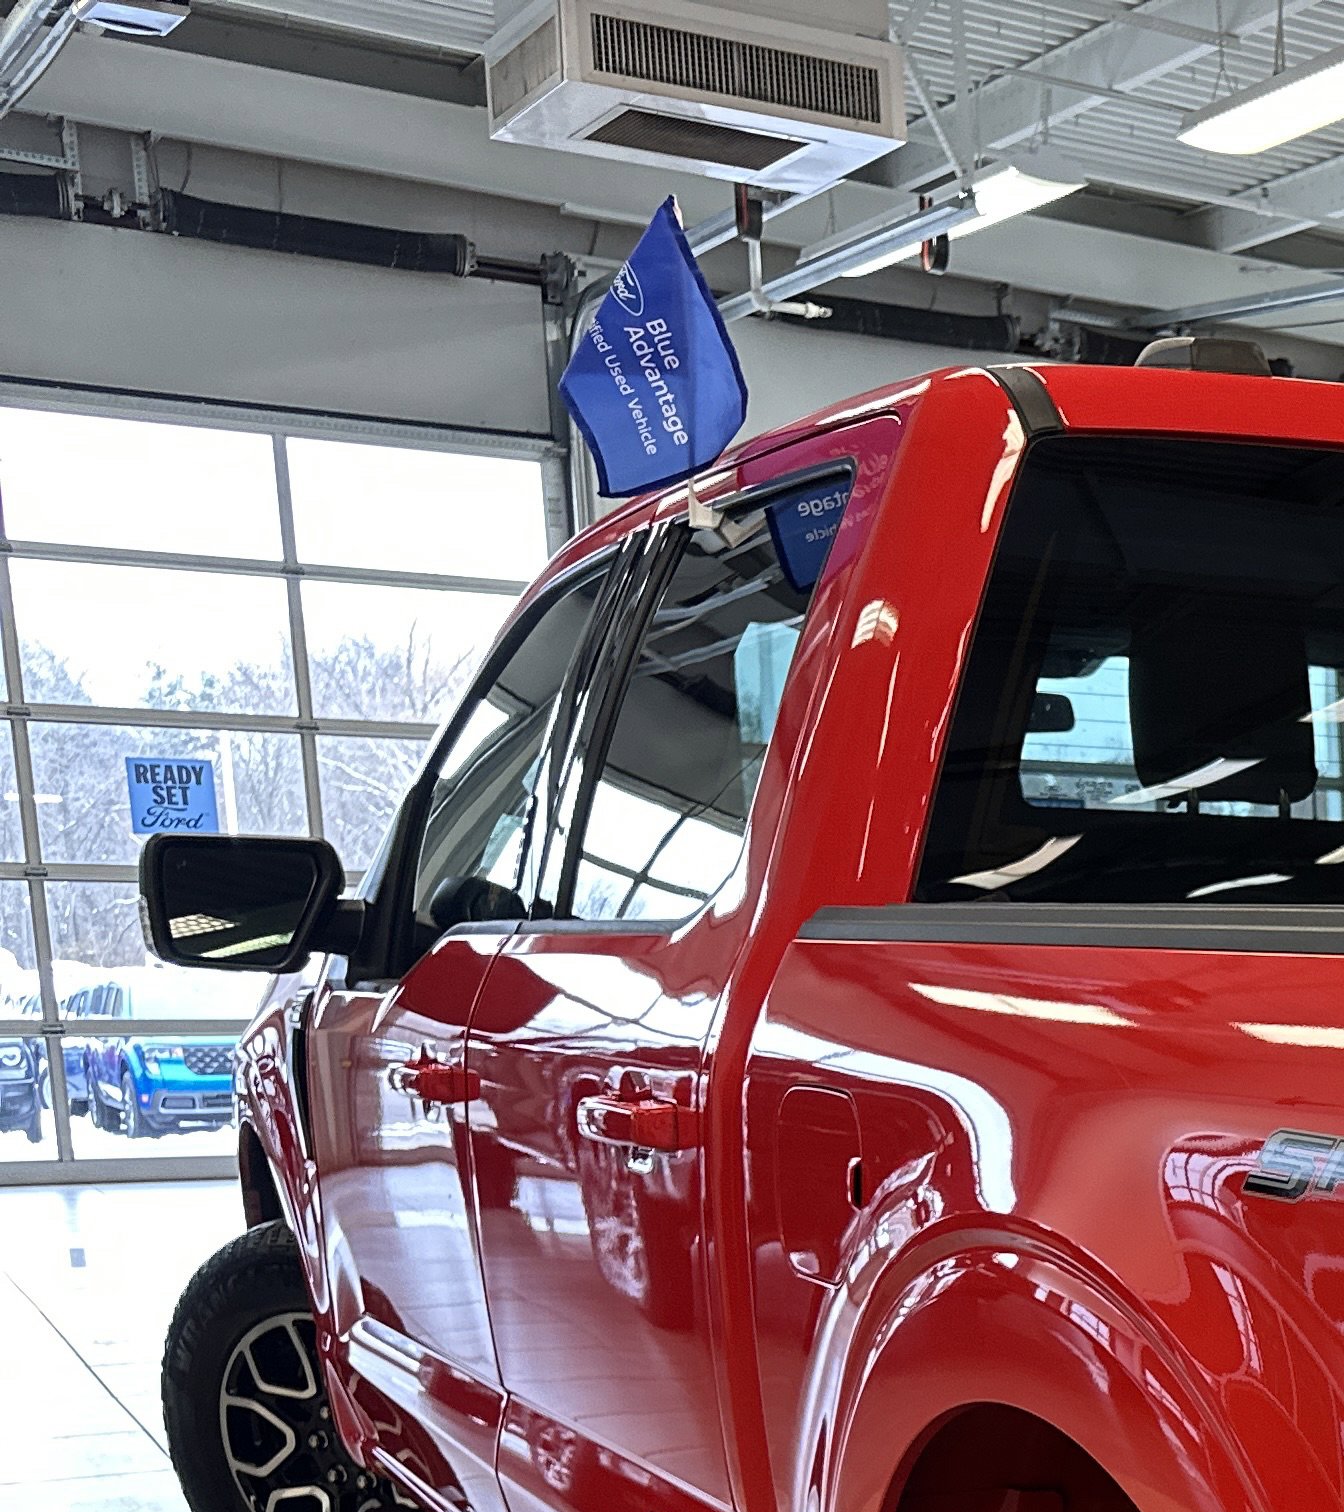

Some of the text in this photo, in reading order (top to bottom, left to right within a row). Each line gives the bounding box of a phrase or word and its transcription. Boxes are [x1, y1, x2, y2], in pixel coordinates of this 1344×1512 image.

[645, 318, 681, 370] Blue
[589, 319, 658, 457] ified Used Vehicle
[623, 326, 690, 447] Advantage
[134, 763, 204, 786] READY
[152, 785, 190, 806] SET
[141, 805, 204, 830] Ford
